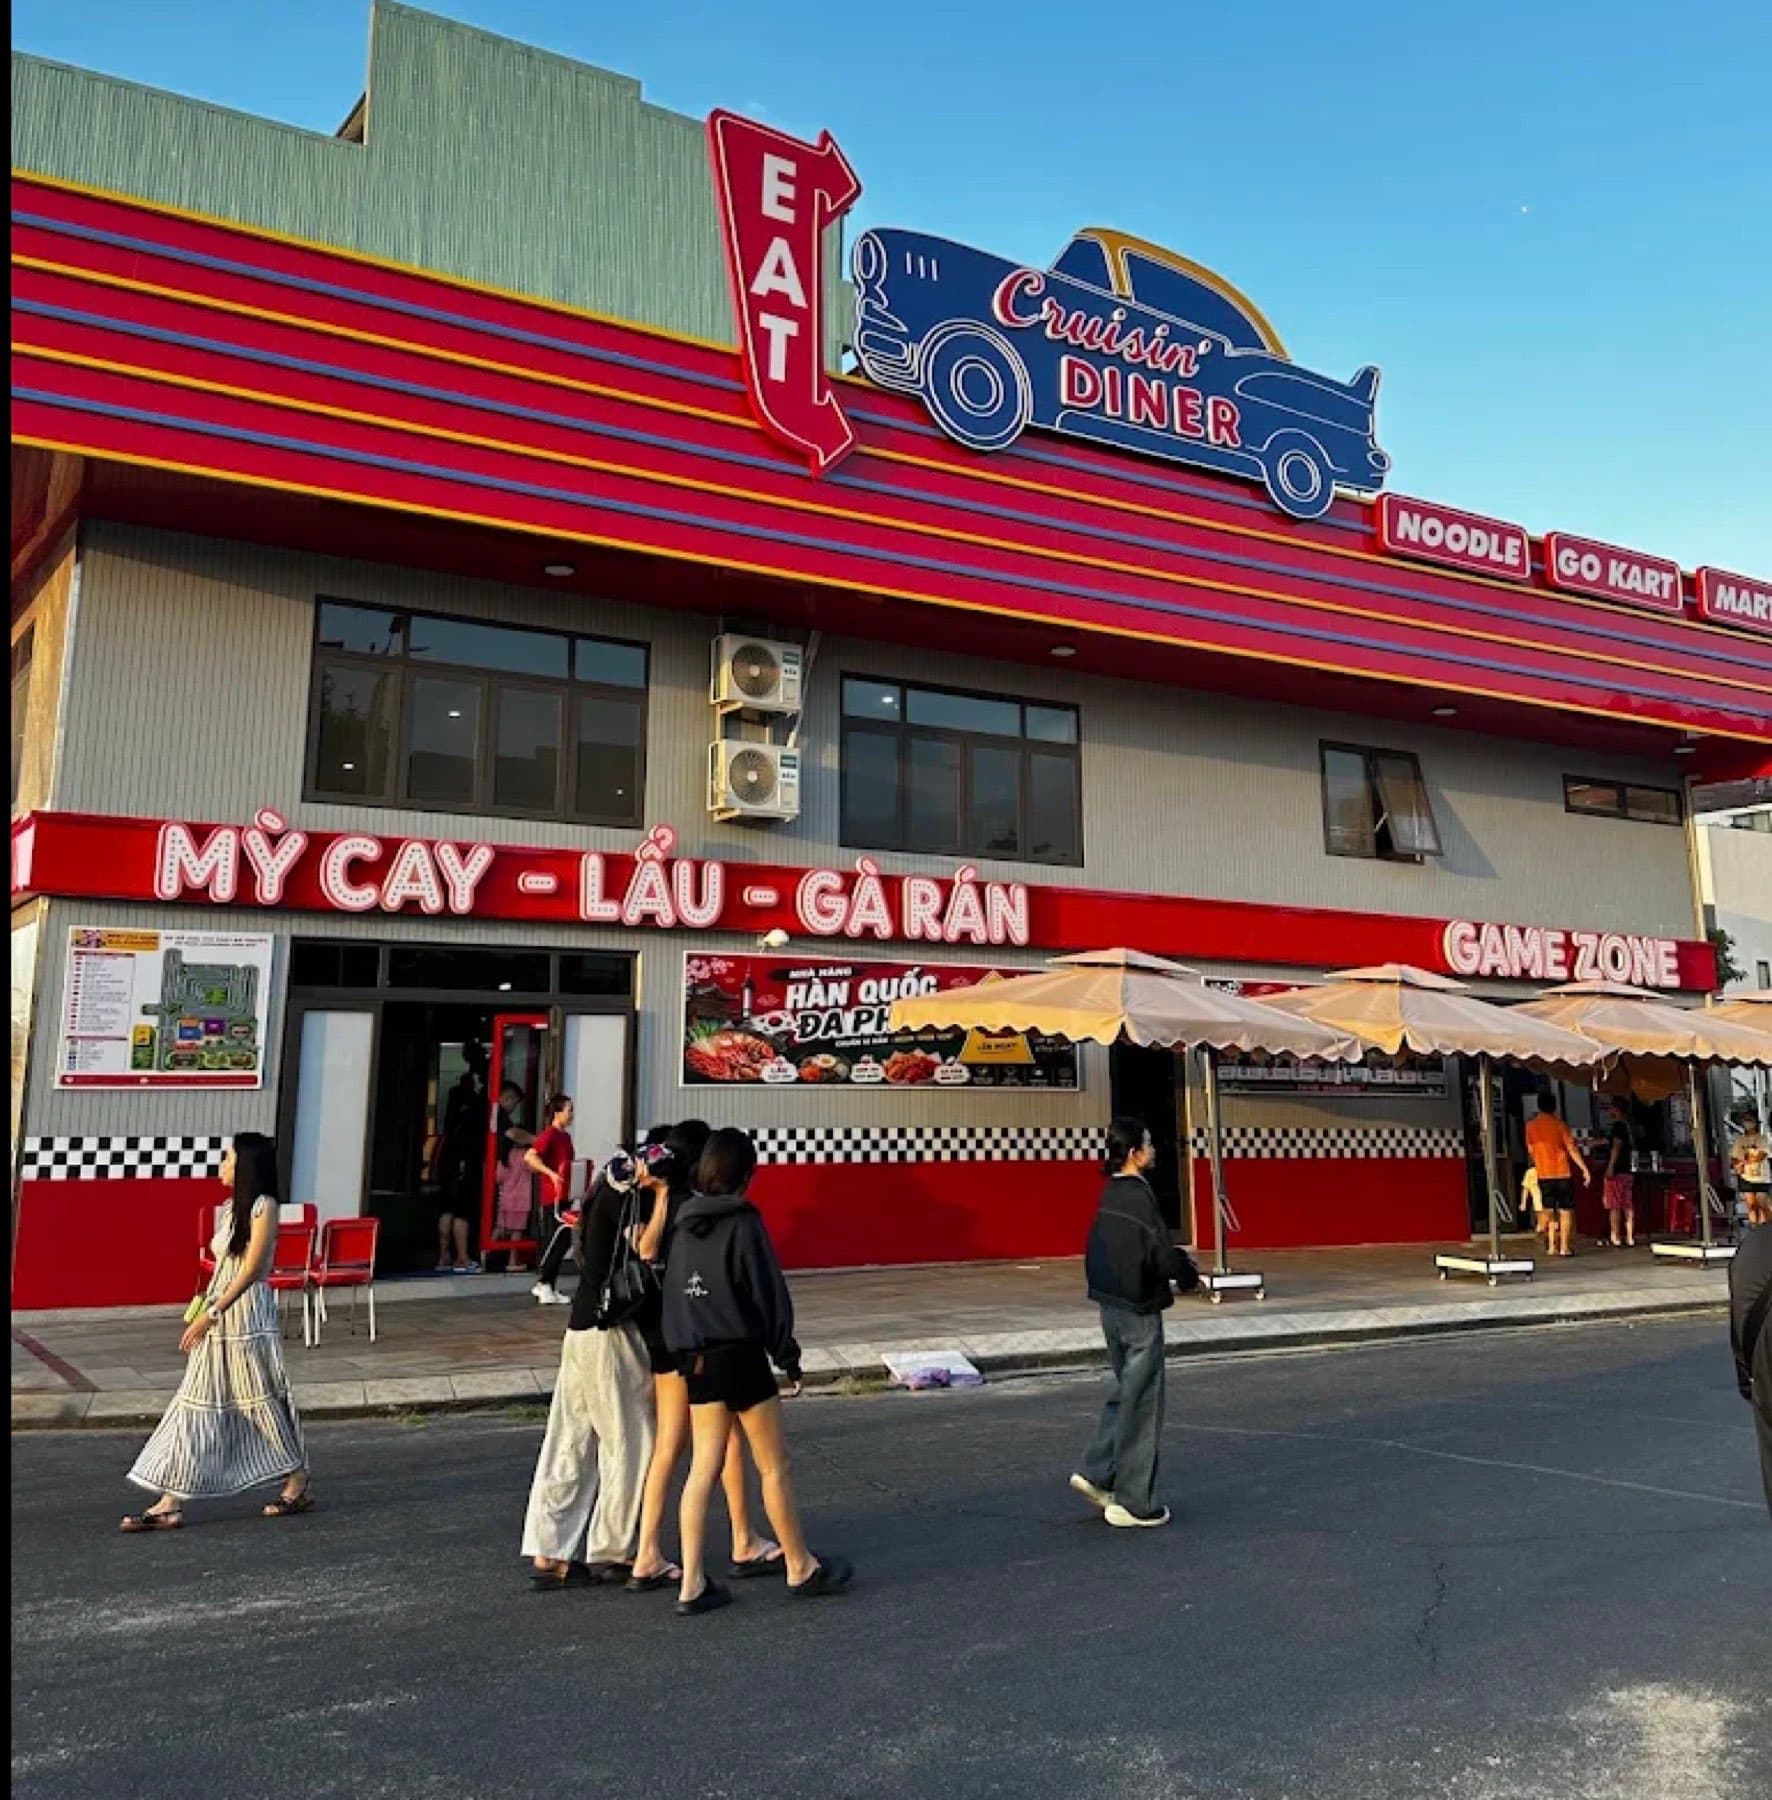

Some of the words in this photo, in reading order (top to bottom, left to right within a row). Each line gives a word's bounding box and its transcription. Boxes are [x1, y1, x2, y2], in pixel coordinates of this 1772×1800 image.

[749, 150, 807, 383] EAT
[991, 267, 1211, 379] Cruisin'
[1060, 354, 1242, 448] DINER
[1396, 510, 1521, 567] NOODLE
[1557, 547, 1601, 581] GO
[1608, 558, 1675, 600] KART
[154, 808, 307, 905] MỲ
[320, 833, 495, 915] CAY
[579, 823, 725, 928] LẨU
[797, 856, 894, 940] GÀ
[902, 864, 1029, 946] RÁN
[785, 977, 850, 1009] HÀN
[858, 966, 938, 1004] QUỐC
[1443, 919, 1569, 980] GAME
[1572, 931, 1681, 988] ZONE
[795, 1008, 846, 1042] ĐA
